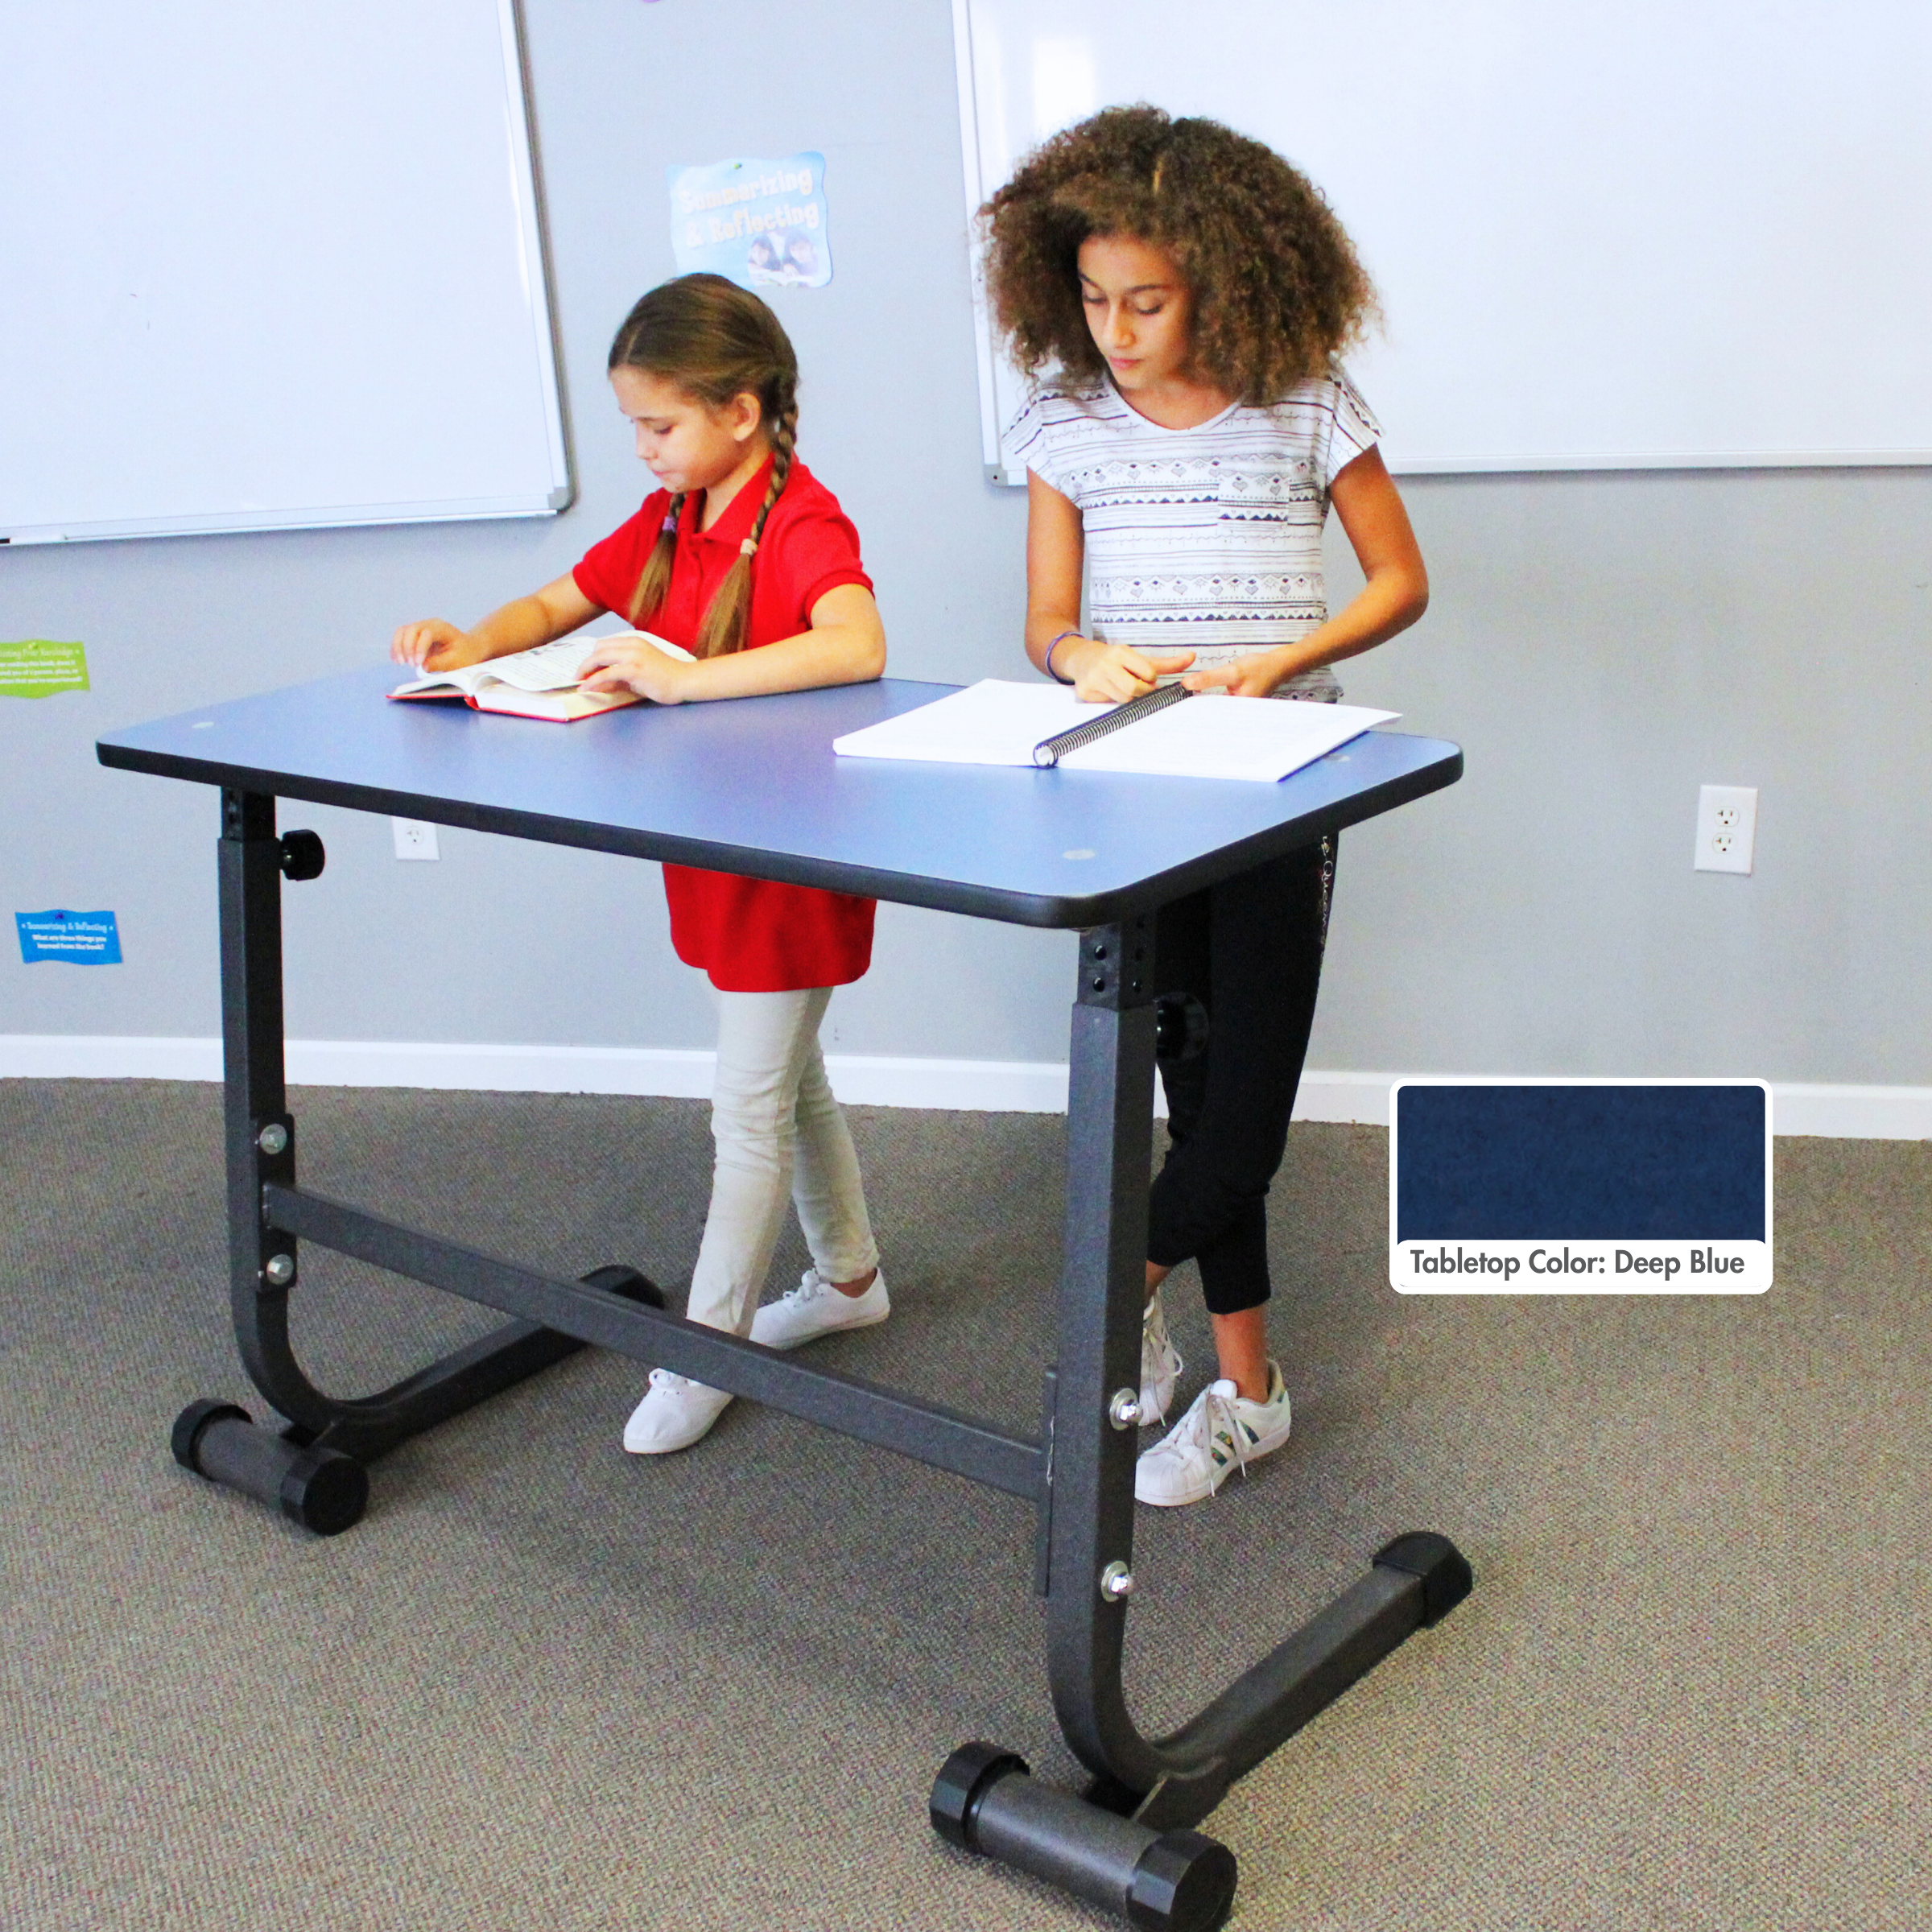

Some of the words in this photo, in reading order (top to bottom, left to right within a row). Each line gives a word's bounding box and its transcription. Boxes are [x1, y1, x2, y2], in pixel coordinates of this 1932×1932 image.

[679, 168, 813, 214] Summarizing
[687, 221, 704, 249] &
[708, 202, 819, 242] Reflecting
